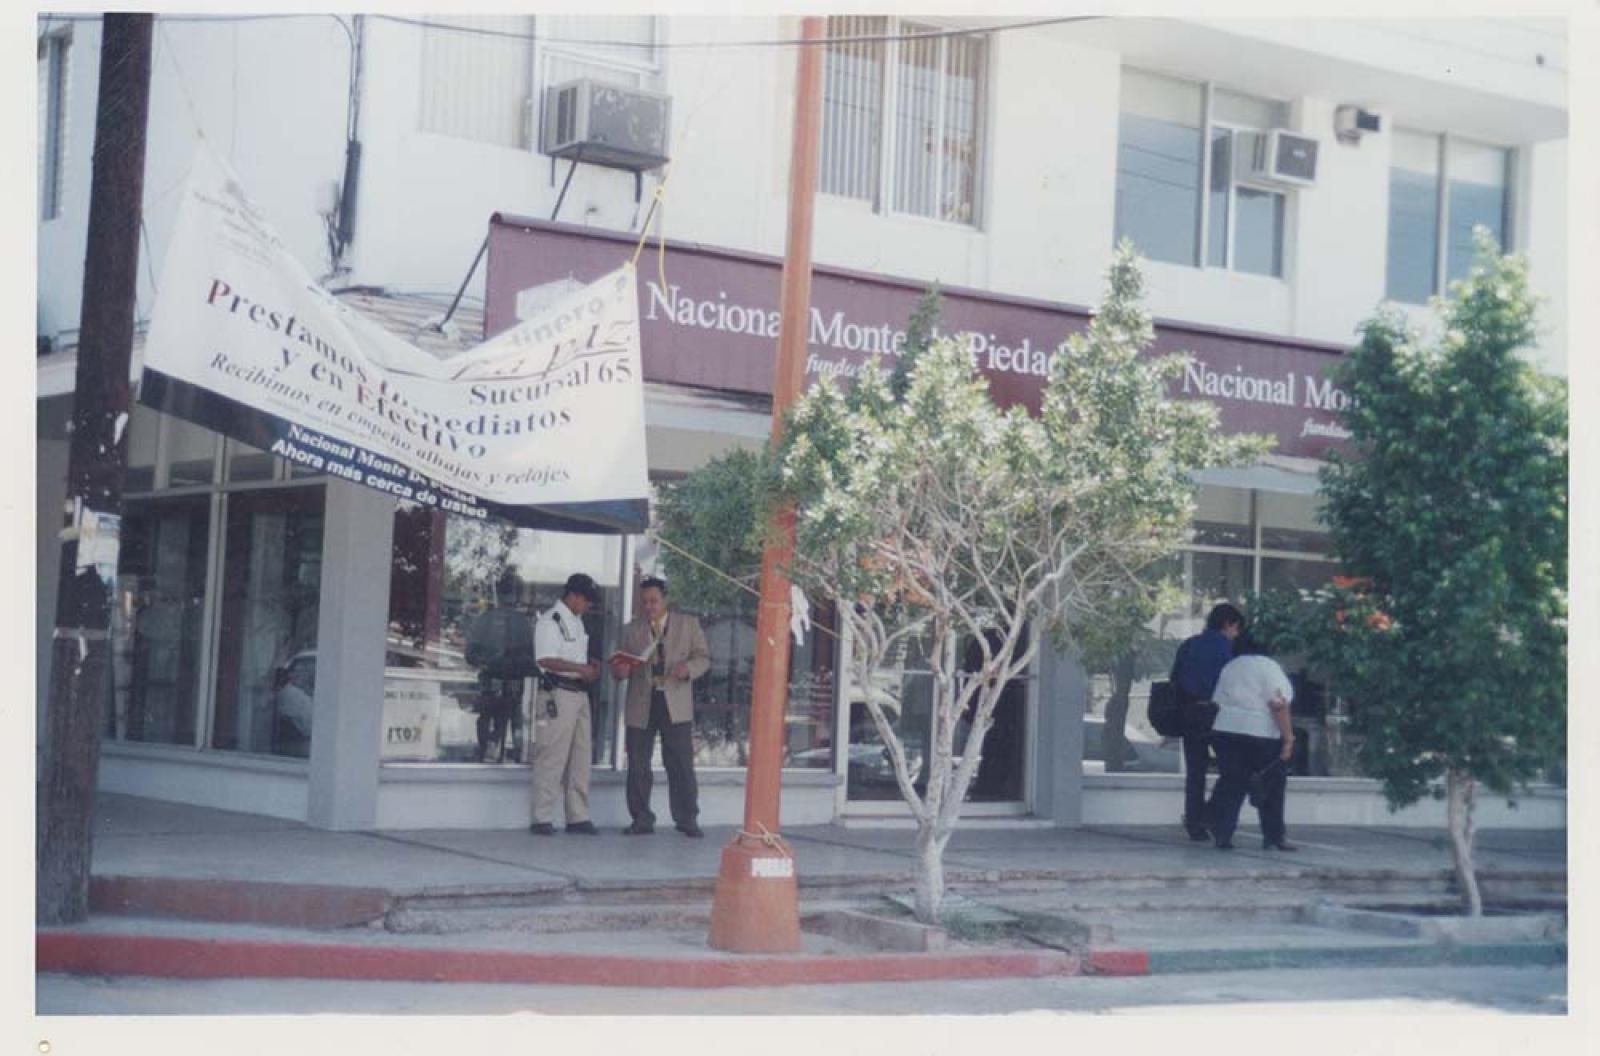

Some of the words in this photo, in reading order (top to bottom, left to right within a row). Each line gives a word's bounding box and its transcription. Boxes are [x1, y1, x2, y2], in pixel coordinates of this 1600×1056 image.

[206, 278, 368, 383] Prestamos
[646, 281, 783, 338] Naciona
[807, 307, 908, 355] Monte
[969, 332, 1053, 377] Pieda
[274, 347, 300, 373] y
[310, 362, 344, 392] en
[356, 382, 487, 458] Efectivo
[598, 358, 633, 384] 65
[1183, 358, 1296, 406] Nacional
[210, 352, 312, 403] Recibimos
[316, 399, 343, 417] en
[415, 448, 482, 483] alhajas
[486, 471, 501, 487] y
[504, 464, 571, 490] relojes
[287, 424, 356, 459] Nacional
[357, 450, 406, 478] Monte
[271, 438, 324, 469] Ahora
[326, 458, 364, 483] más
[366, 475, 413, 499] cerca
[415, 488, 438, 505] de
